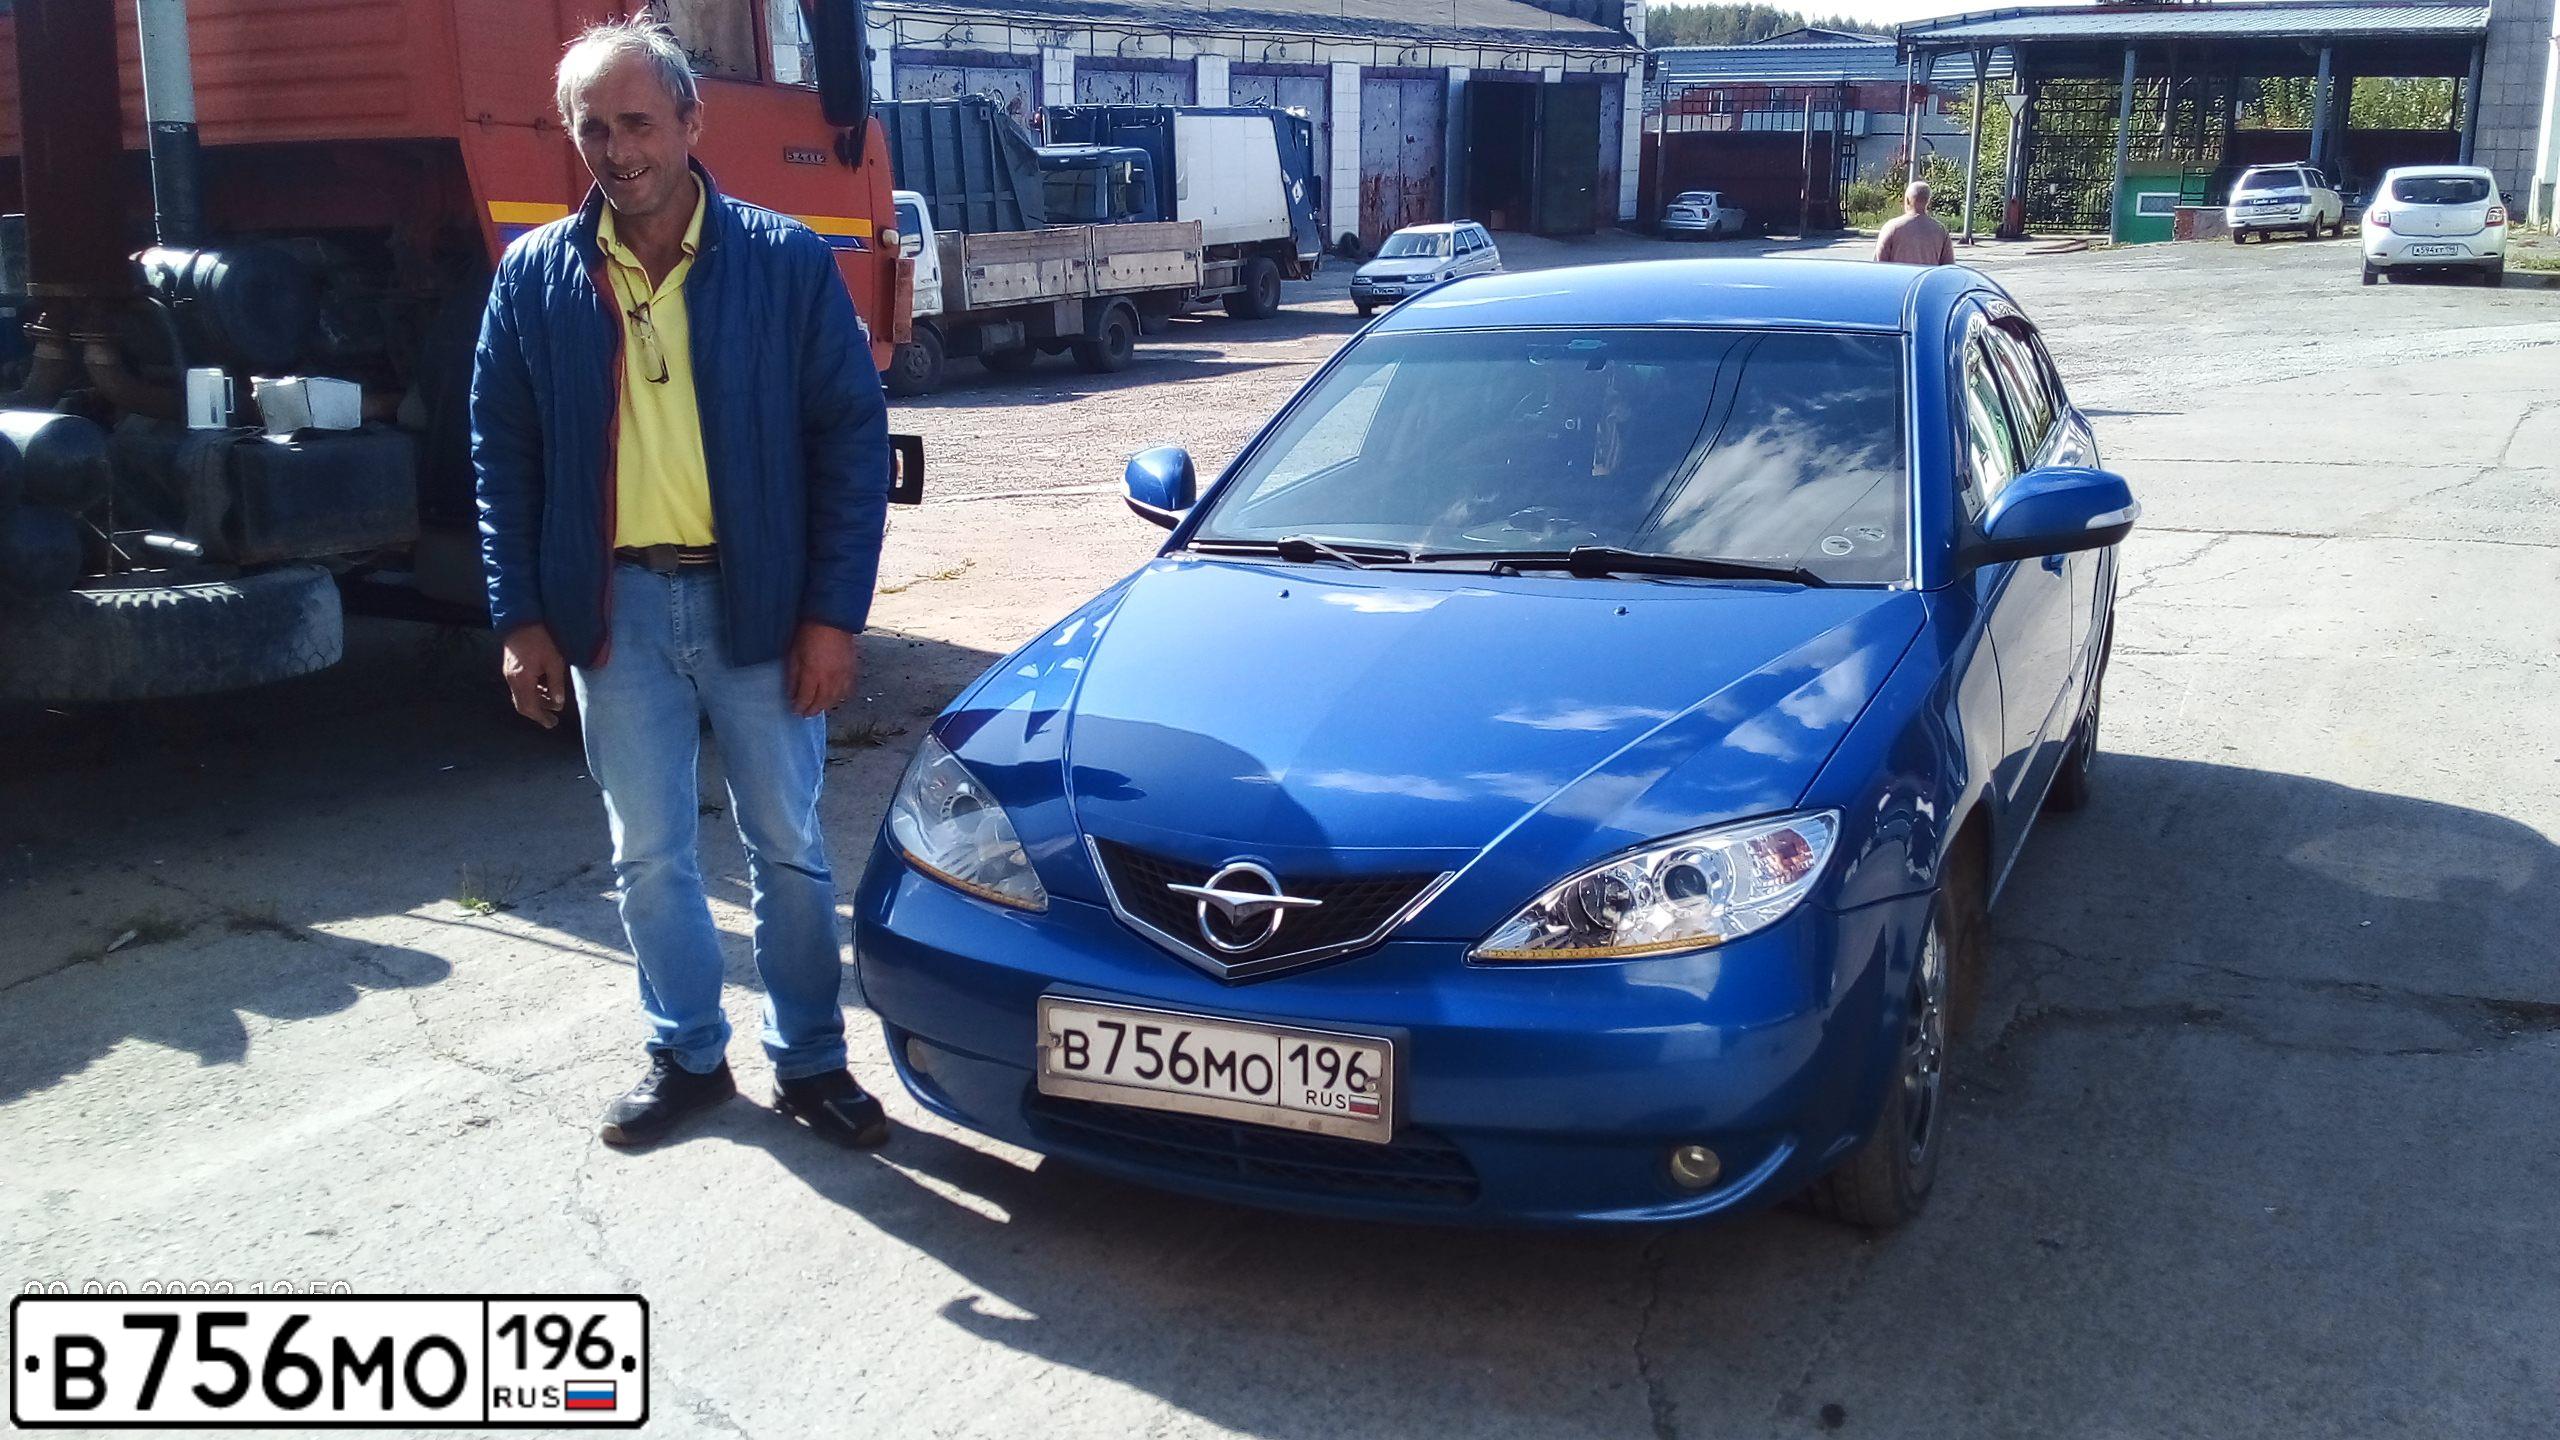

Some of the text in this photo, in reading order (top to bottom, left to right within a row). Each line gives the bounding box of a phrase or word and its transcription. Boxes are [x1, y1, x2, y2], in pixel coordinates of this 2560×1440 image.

[1063, 1020, 1371, 1095] В756МО 196
[1306, 1090, 1347, 1109] RUS
